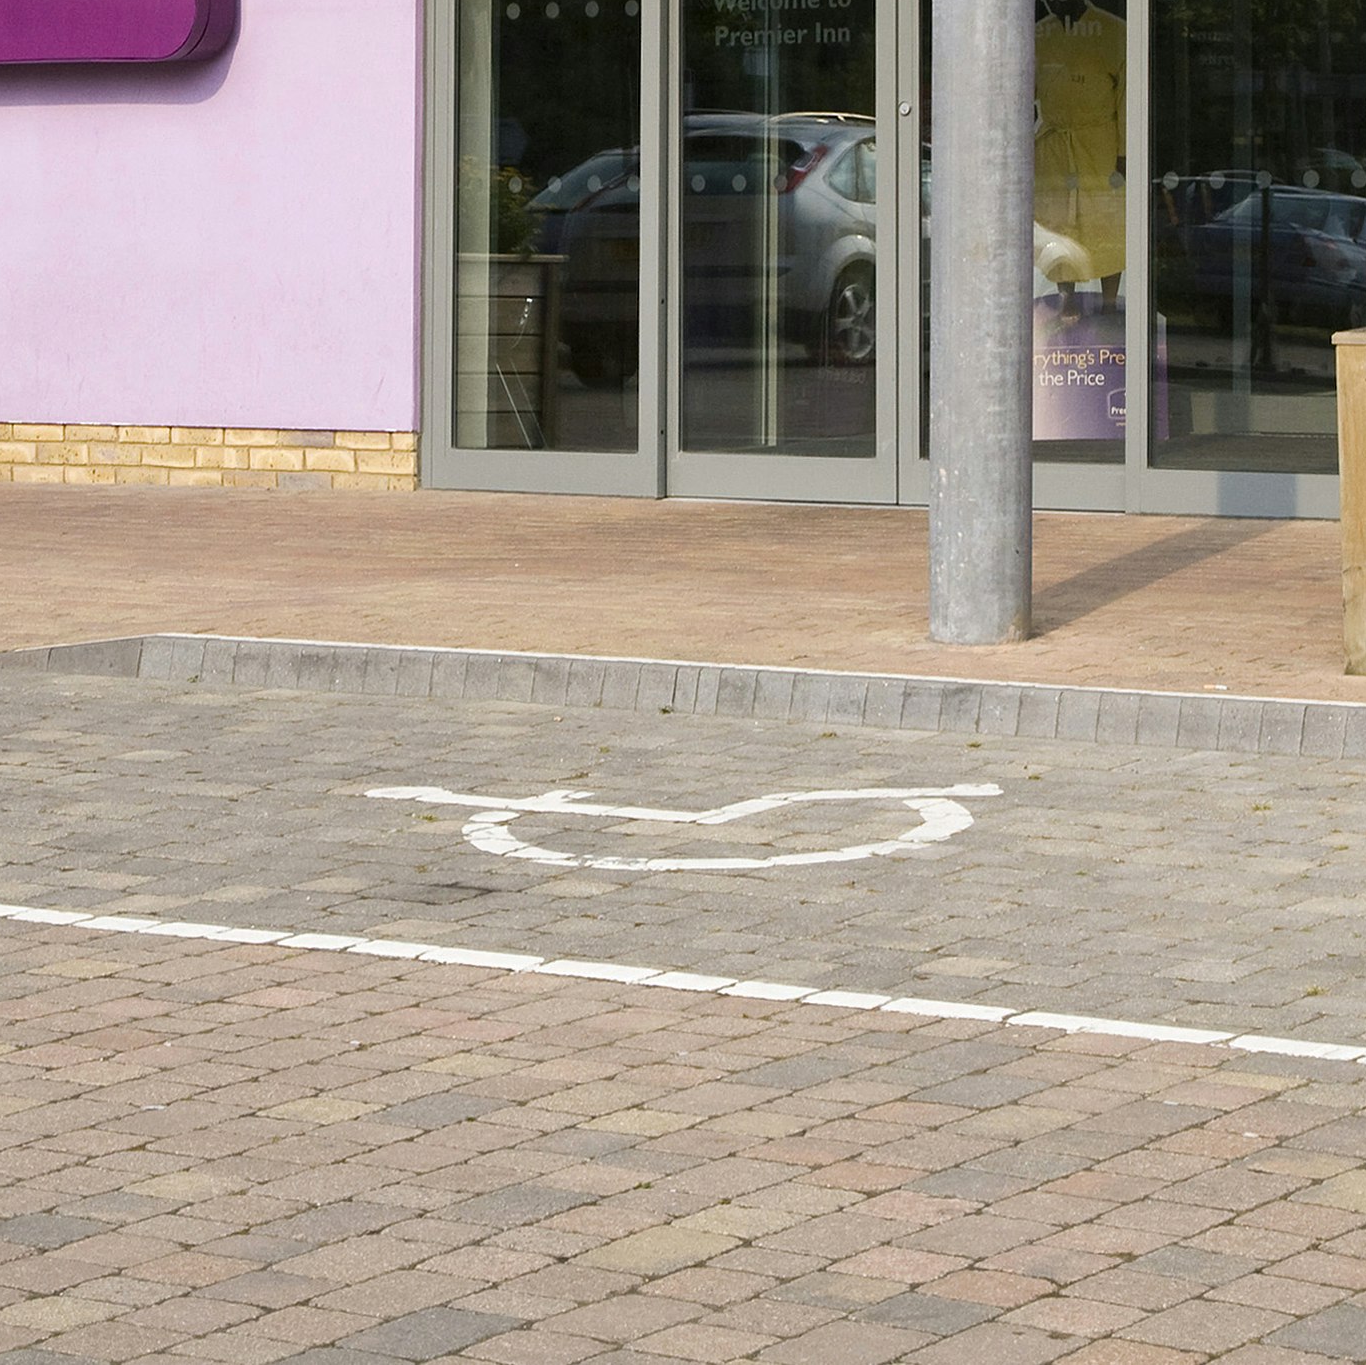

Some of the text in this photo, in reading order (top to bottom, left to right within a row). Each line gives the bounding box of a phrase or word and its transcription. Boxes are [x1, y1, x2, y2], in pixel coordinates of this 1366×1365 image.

[714, 21, 851, 46] Premier Inn
[1034, 349, 1095, 370] rything's
[1038, 369, 1105, 386] the Price
